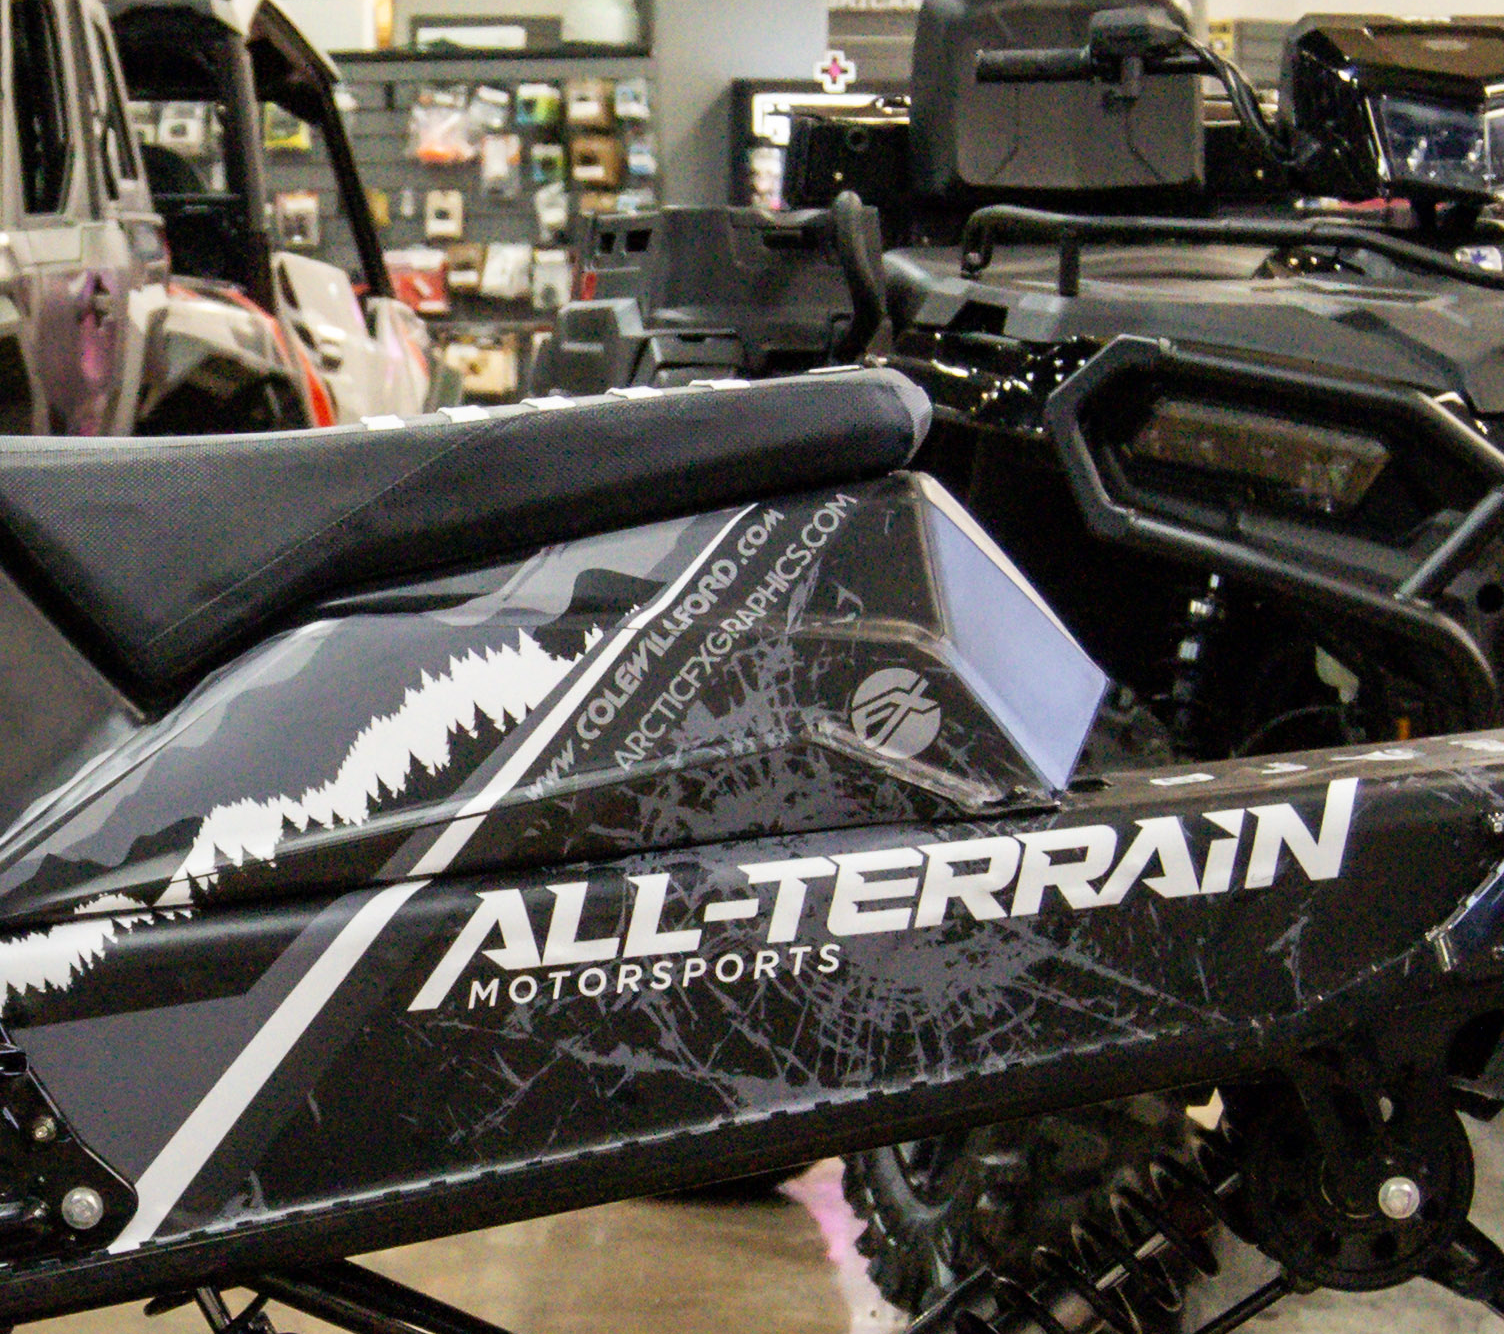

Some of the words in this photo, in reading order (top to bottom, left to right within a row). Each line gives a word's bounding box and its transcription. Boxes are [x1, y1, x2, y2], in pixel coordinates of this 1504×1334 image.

[613, 493, 858, 771] ARCTICFXGRAPHICS.COM
[408, 777, 1358, 1012] ALL-TERRAIN
[468, 943, 841, 1011] MOTORSPORTS
